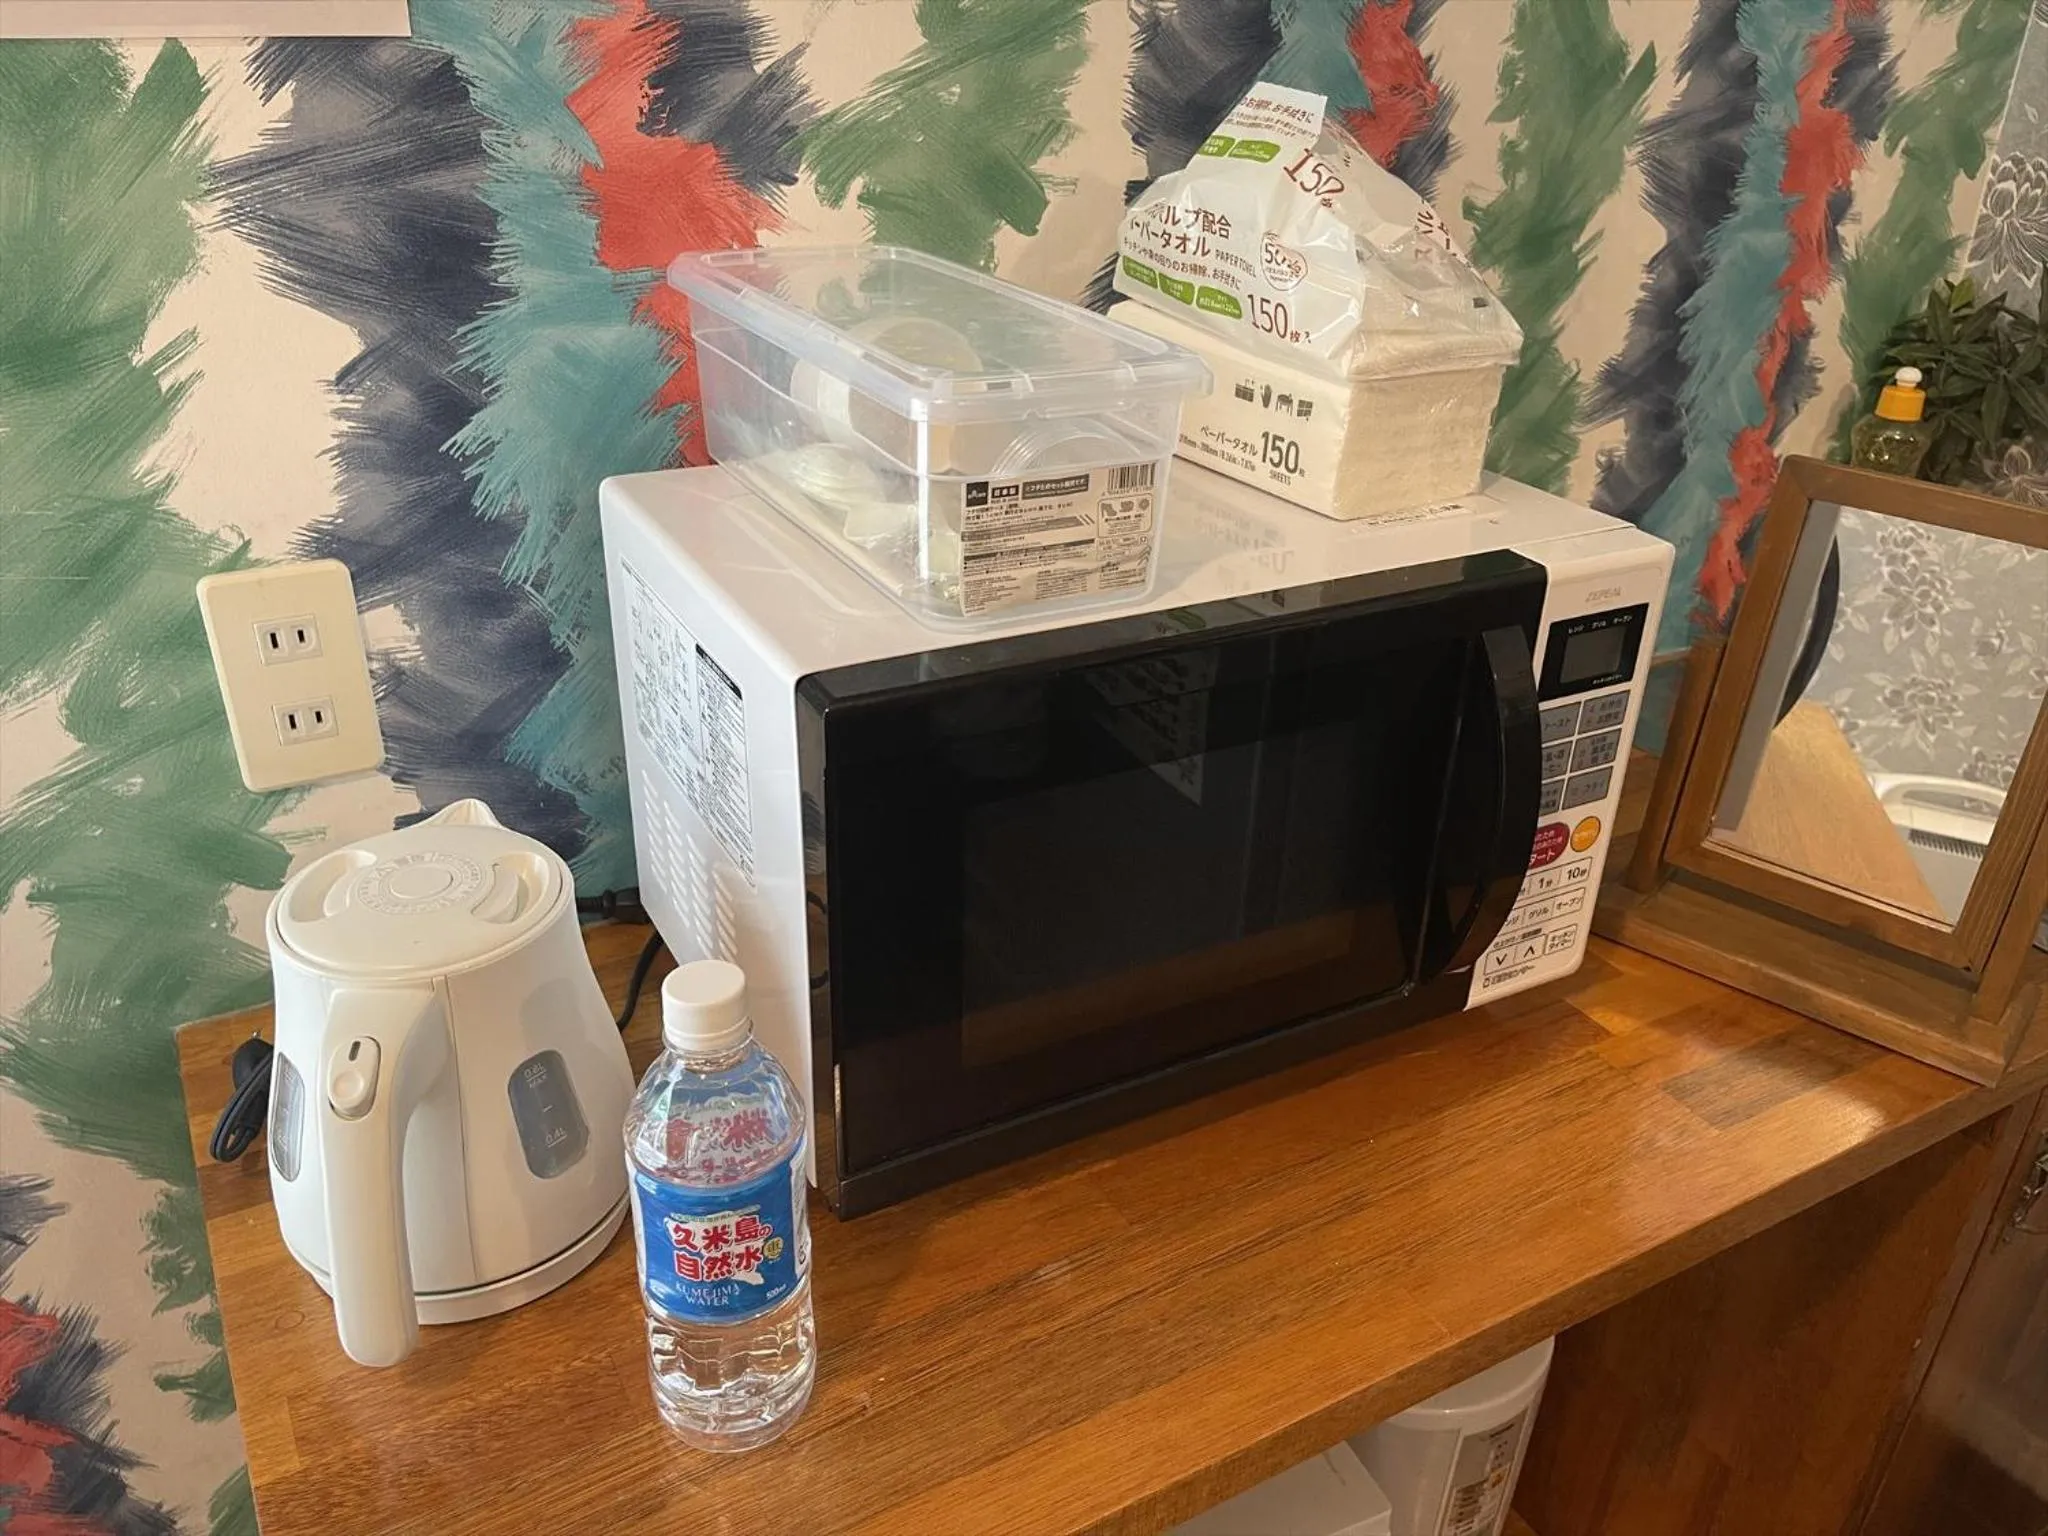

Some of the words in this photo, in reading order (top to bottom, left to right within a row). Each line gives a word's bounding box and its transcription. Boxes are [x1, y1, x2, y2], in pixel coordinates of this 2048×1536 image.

[1200, 425, 1258, 457] ペーパータオル
[672, 1215, 772, 1252] 久米島の
[674, 1246, 762, 1281] 自然水
[675, 1282, 741, 1297] KUMEJIMA
[686, 1295, 729, 1306] WATER
